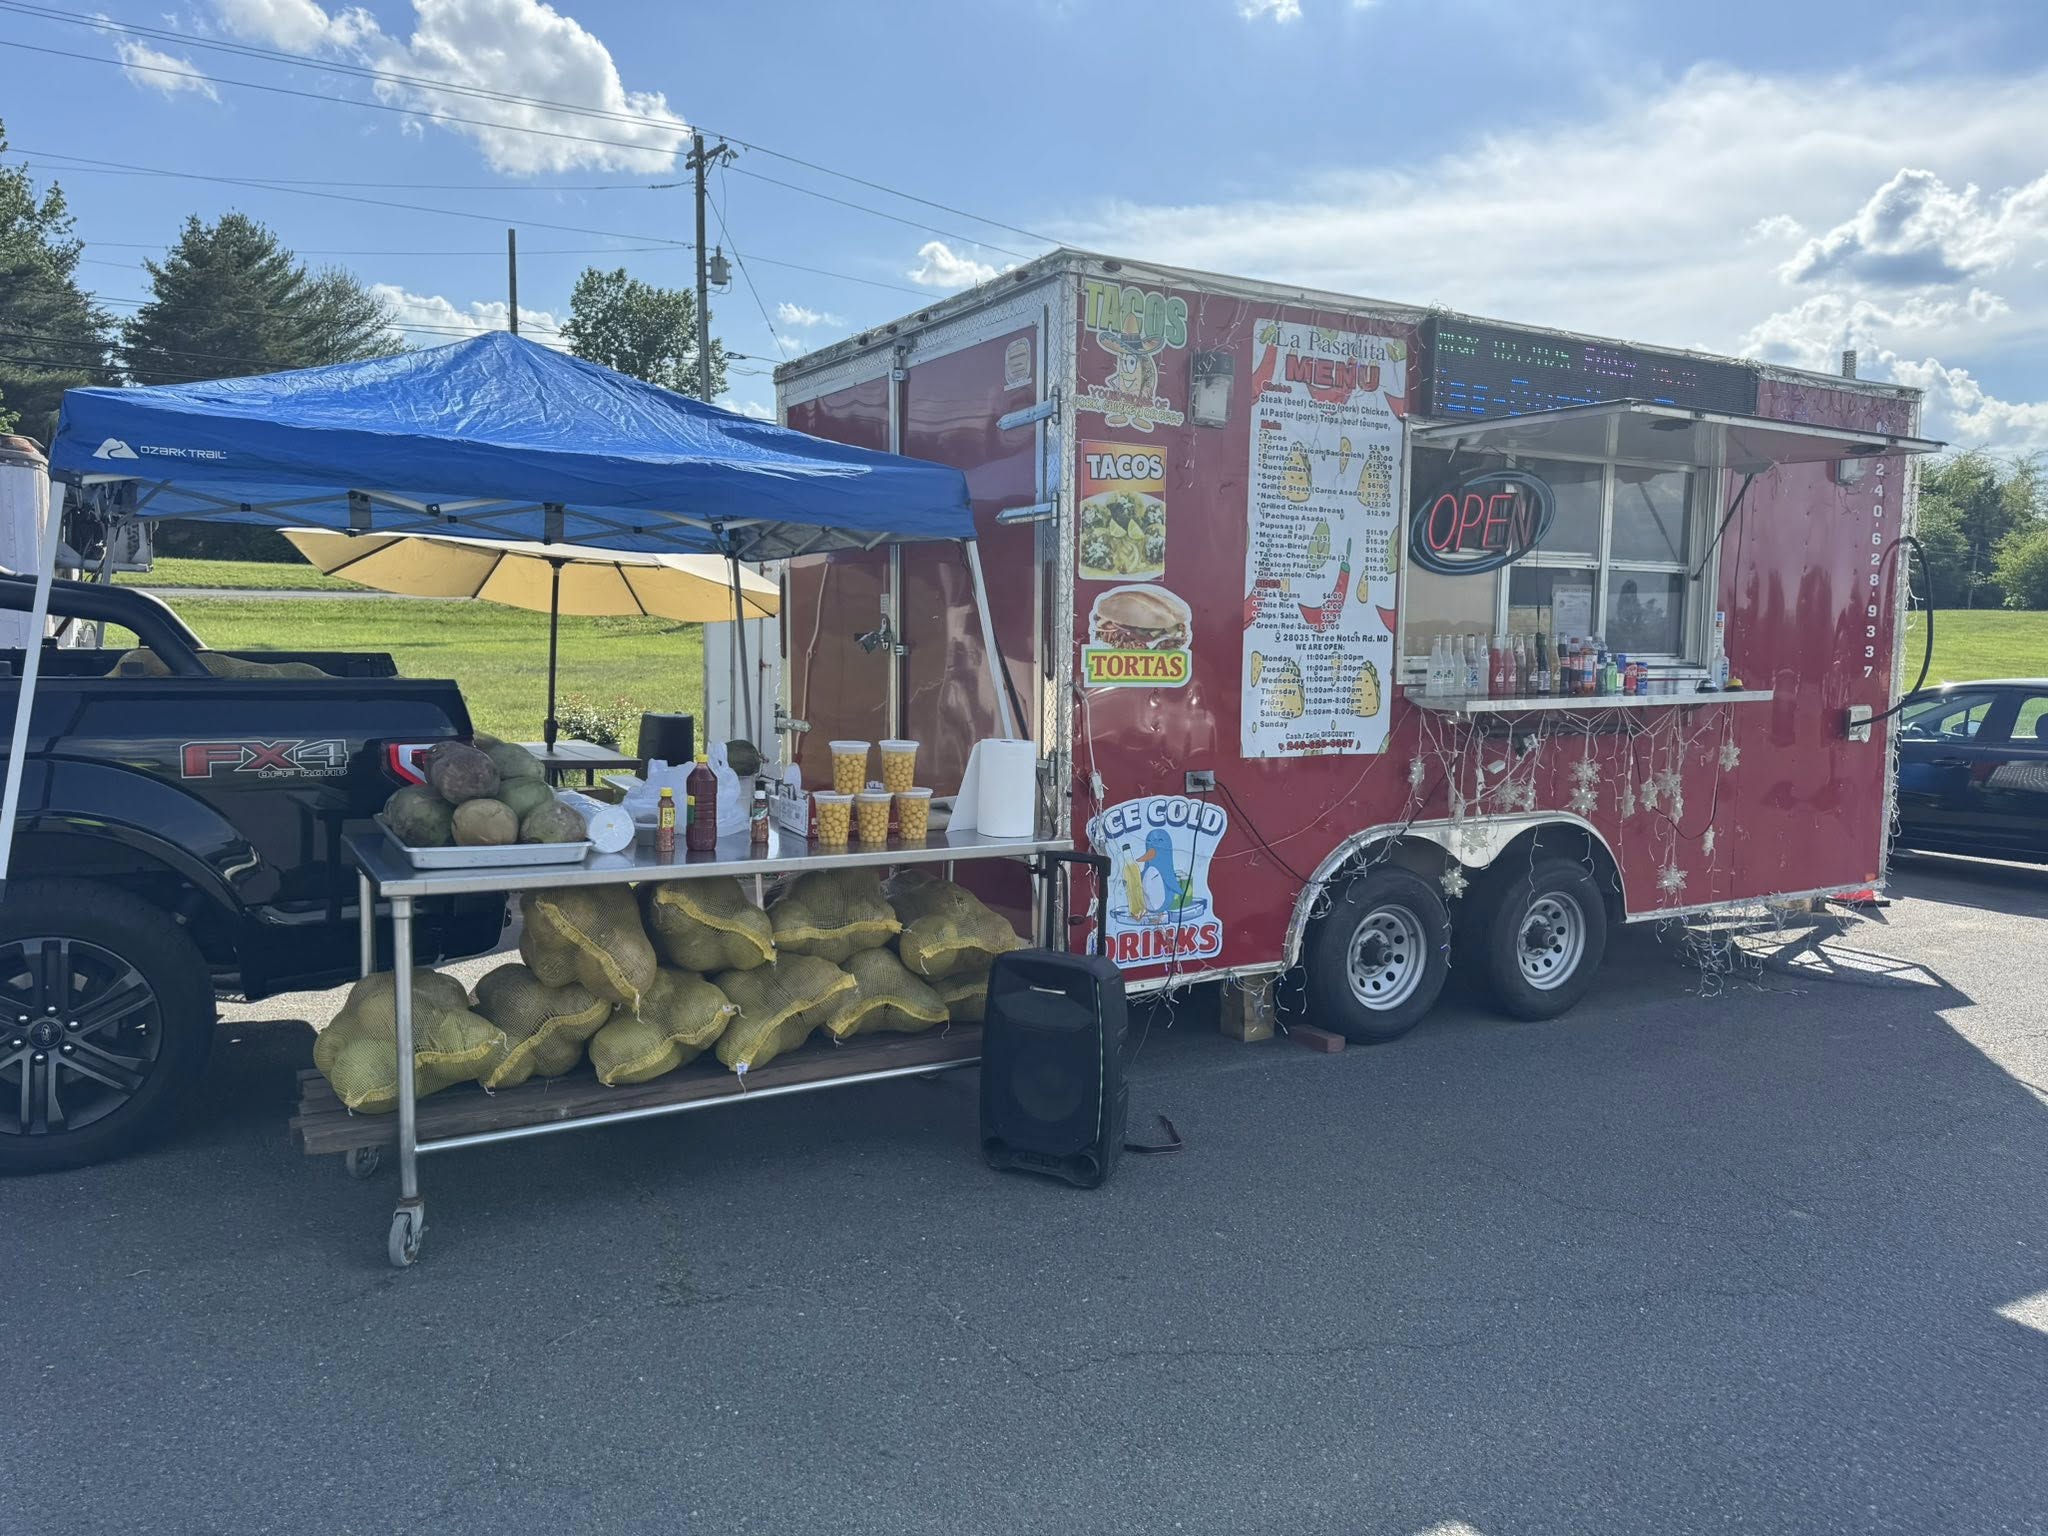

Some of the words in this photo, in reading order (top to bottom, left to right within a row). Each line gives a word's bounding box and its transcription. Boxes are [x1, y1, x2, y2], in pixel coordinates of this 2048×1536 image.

[1086, 279, 1188, 347] TACOS
[1276, 327, 1300, 348] La
[1309, 332, 1385, 360] Pasadita
[1286, 354, 1380, 392] MENU
[1260, 394, 1282, 404] Steak
[1284, 398, 1306, 409] (beef)
[1308, 400, 1336, 411] Chorizo
[1337, 404, 1359, 415] (pork)
[1361, 406, 1389, 417] Chicken
[1260, 408, 1268, 417] Al
[1269, 408, 1294, 419] Pastor
[1296, 411, 1318, 423] (pork)
[1263, 433, 1287, 441] Tacos
[1263, 443, 1290, 452] Tortas
[1262, 453, 1293, 462] Burritos
[1086, 453, 1163, 480] TACOS
[1262, 463, 1306, 473] Quesadillas
[1261, 483, 1286, 491] Grilled
[1289, 485, 1309, 494] Steak
[1339, 489, 1365, 498] Asada)
[1261, 493, 1290, 501] Nachos
[1261, 502, 1286, 510] Grilled
[1288, 504, 1317, 512] Chicken
[1302, 514, 1327, 523] Asada)
[1428, 493, 1535, 551] OPEN
[1260, 522, 1293, 532] Pupusas
[1365, 529, 1389, 537] $11.99
[1259, 532, 1292, 540] Mexican
[1258, 561, 1290, 569] Mexican
[1293, 562, 1320, 570] Flautas
[1258, 570, 1326, 580] Guacamole/Chips
[1364, 574, 1389, 582] $10.00
[1863, 463, 1884, 679] 240-628-9337
[1255, 579, 1281, 589] SIDES
[1256, 590, 1277, 598] Black
[1279, 591, 1300, 599] Beans
[1256, 601, 1277, 609] White
[1279, 601, 1294, 609] Rice
[1256, 611, 1299, 620] Chips/Salsa
[1283, 633, 1310, 641] 28035
[1311, 634, 1335, 642] Three
[1336, 633, 1361, 642] Notch
[1362, 634, 1376, 642] Rd.
[1262, 654, 1292, 662] Monday
[1091, 654, 1182, 677] TORTAS
[1261, 677, 1304, 685] Wednesday
[1261, 688, 1297, 696] Thursday
[1260, 709, 1295, 718] Saturday
[1260, 720, 1289, 729] Sunday
[180, 739, 348, 778] FX4
[258, 770, 295, 778] OFF
[301, 768, 347, 777] ROAD
[1147, 799, 1223, 836] COLD
